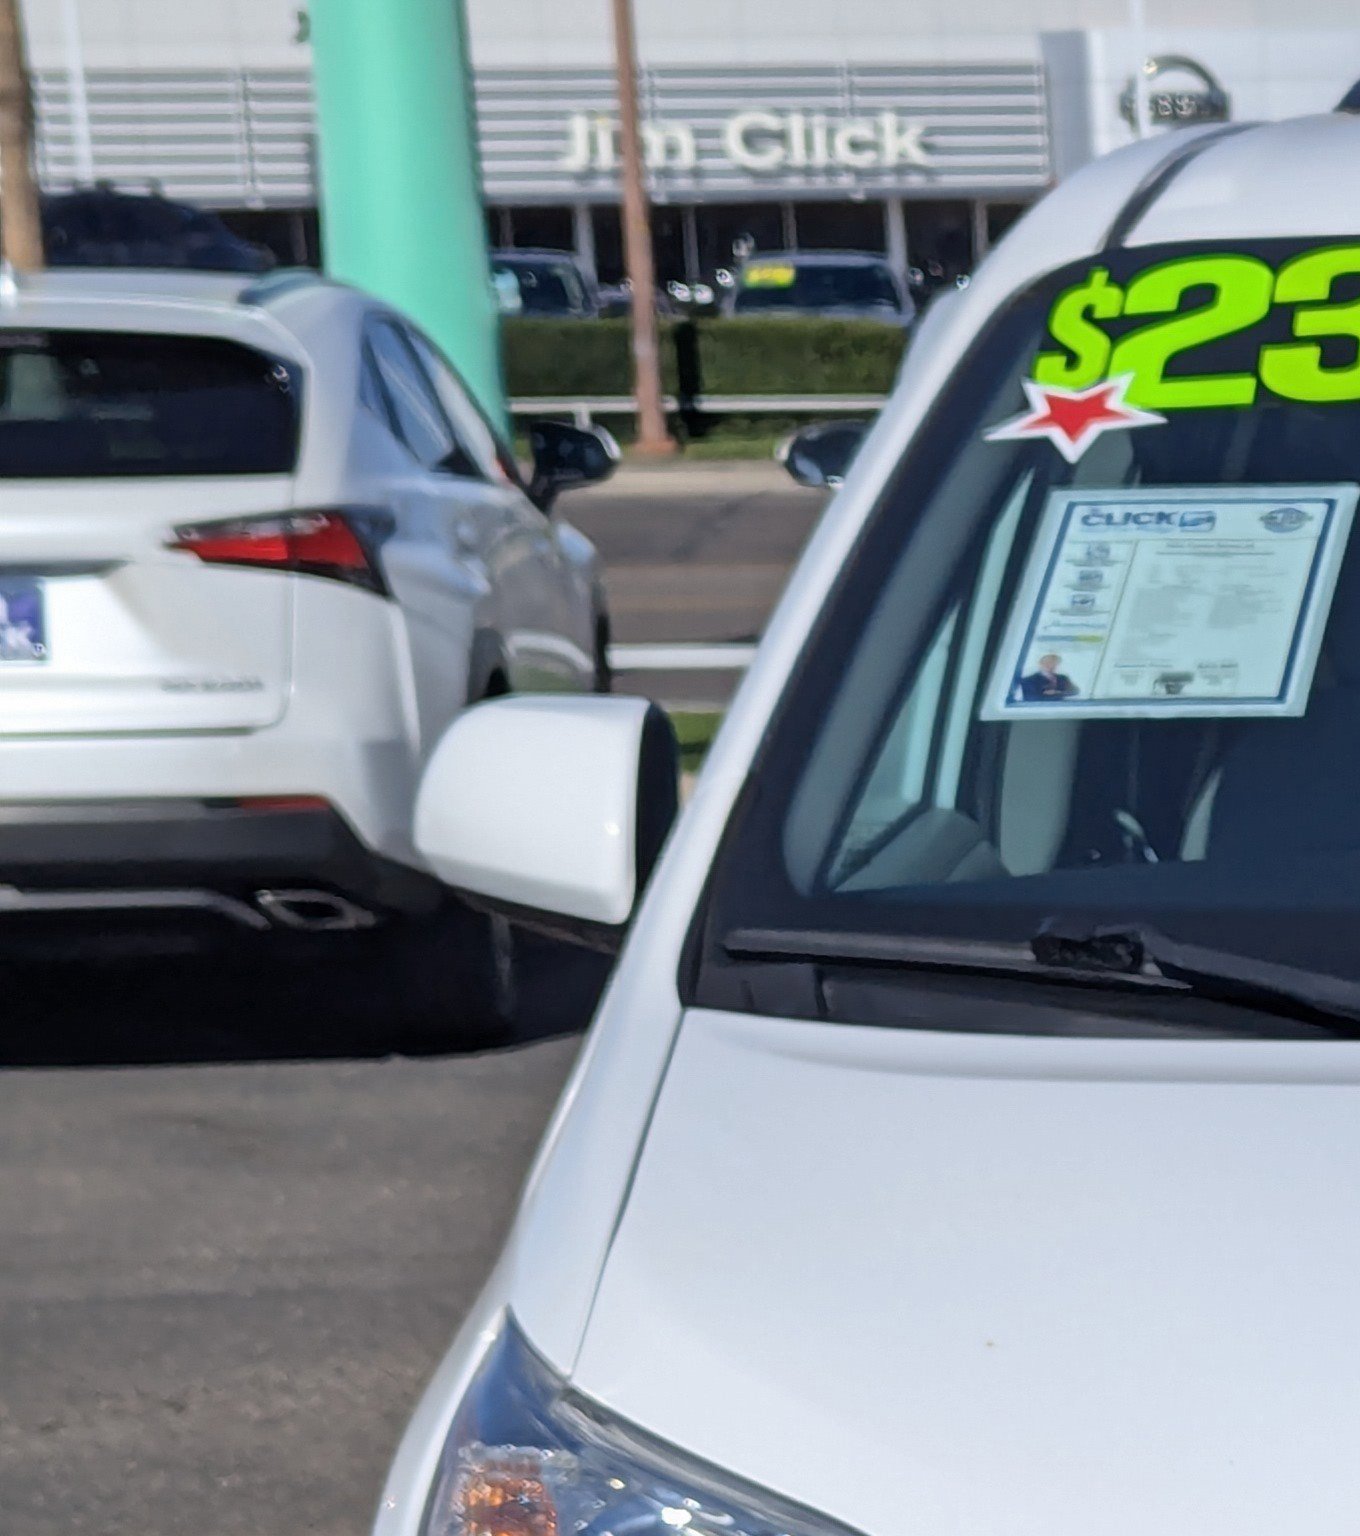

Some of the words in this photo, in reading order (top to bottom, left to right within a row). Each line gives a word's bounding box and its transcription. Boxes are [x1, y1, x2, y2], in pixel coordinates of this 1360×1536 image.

[562, 112, 698, 172] Jim
[722, 110, 929, 171] Click
[1080, 510, 1180, 527] CLICK
